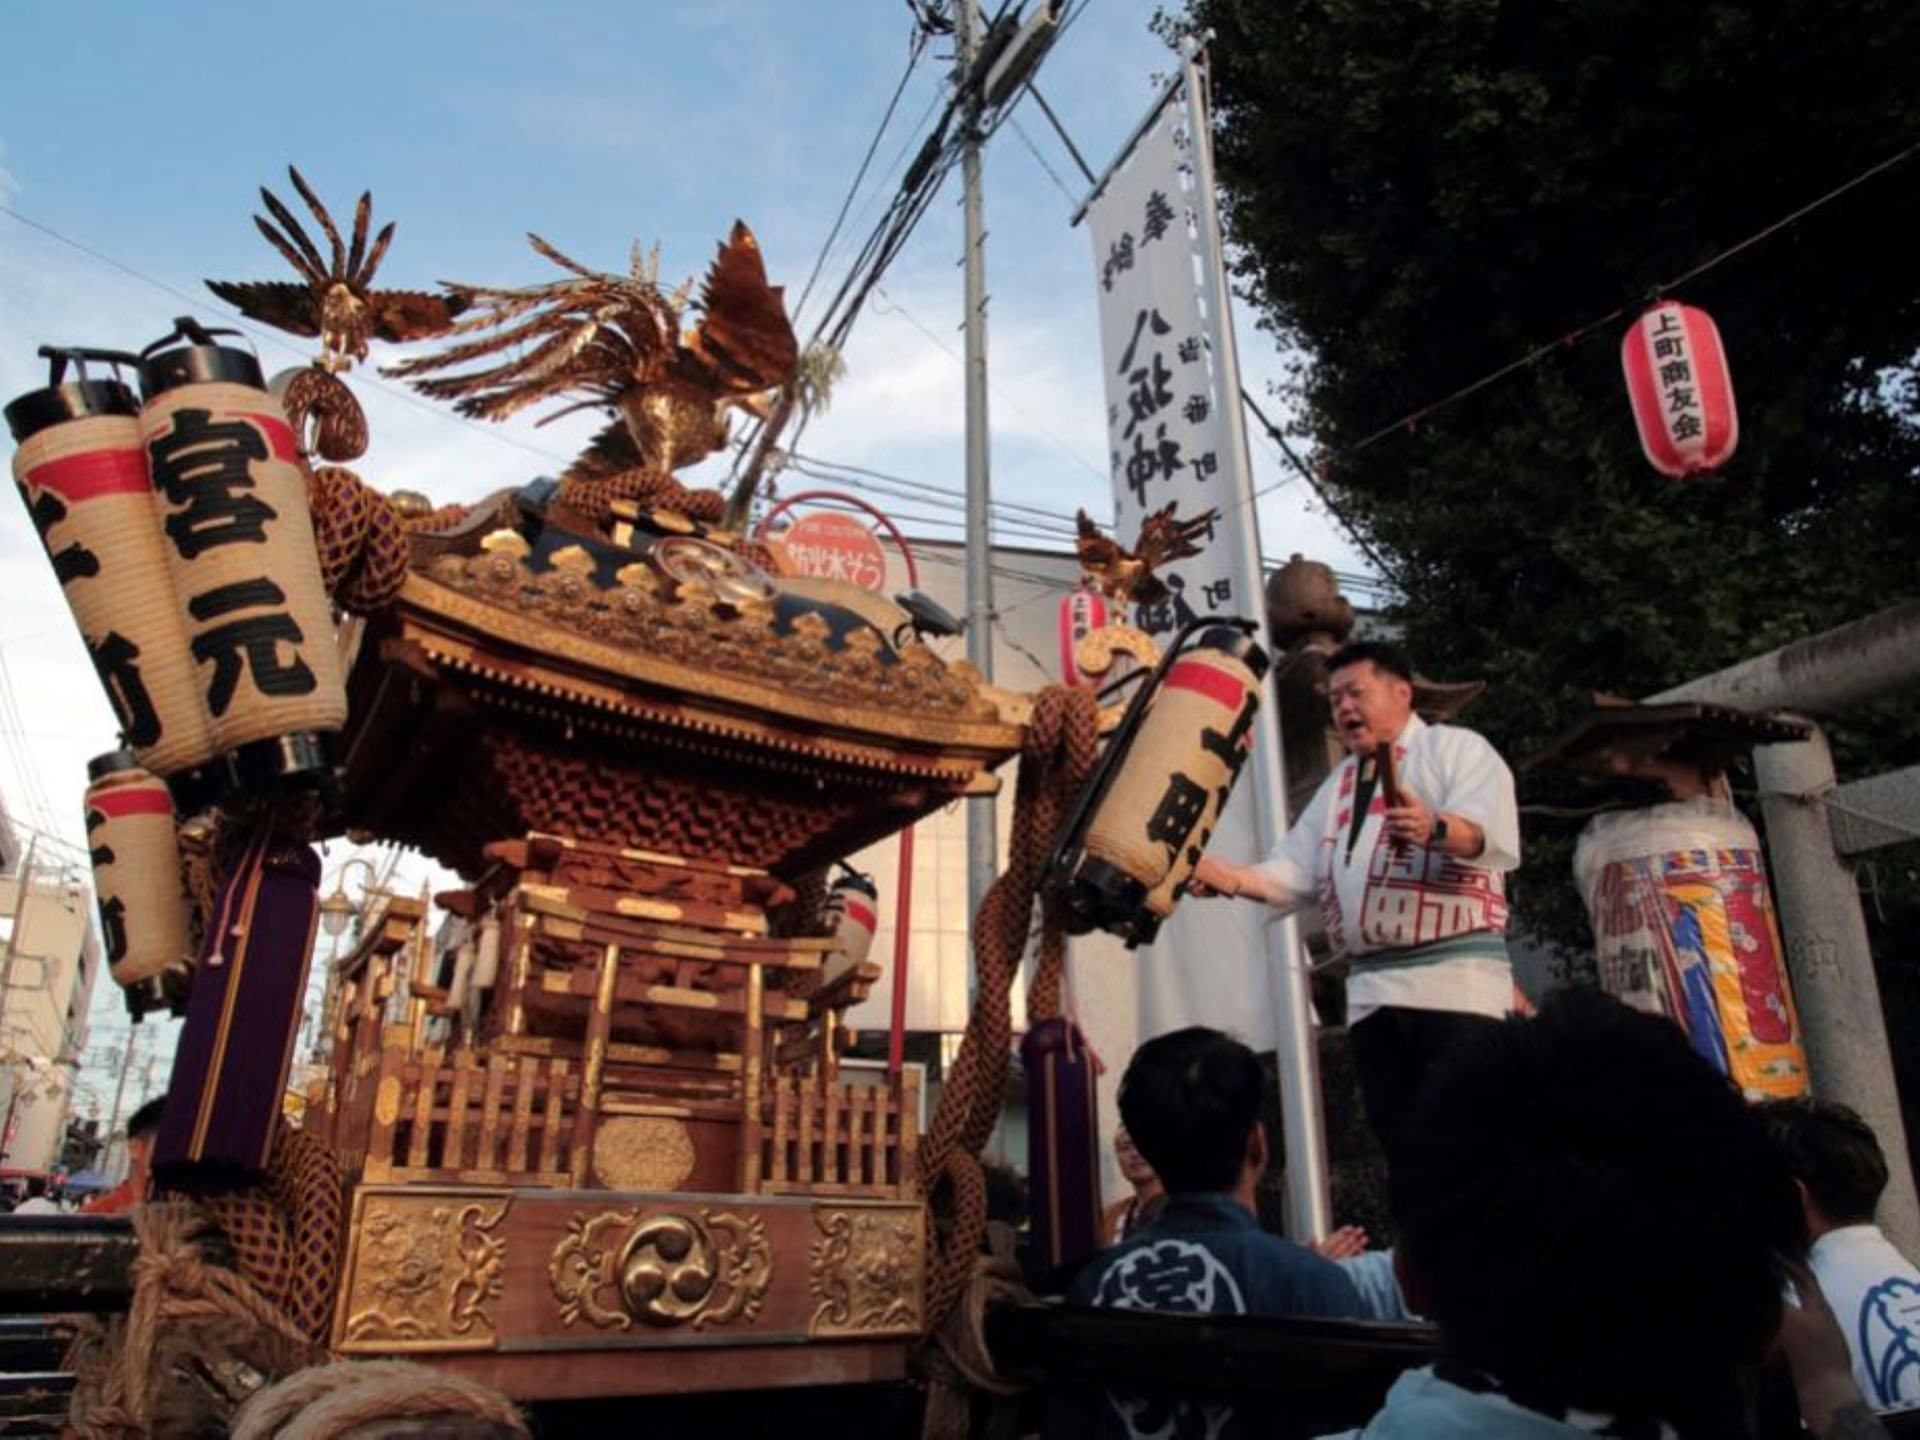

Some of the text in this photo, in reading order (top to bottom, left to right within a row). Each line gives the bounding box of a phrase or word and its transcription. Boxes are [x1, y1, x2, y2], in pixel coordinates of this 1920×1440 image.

[1652, 313, 1702, 441] 上町商友会
[148, 408, 317, 718] 宮元
